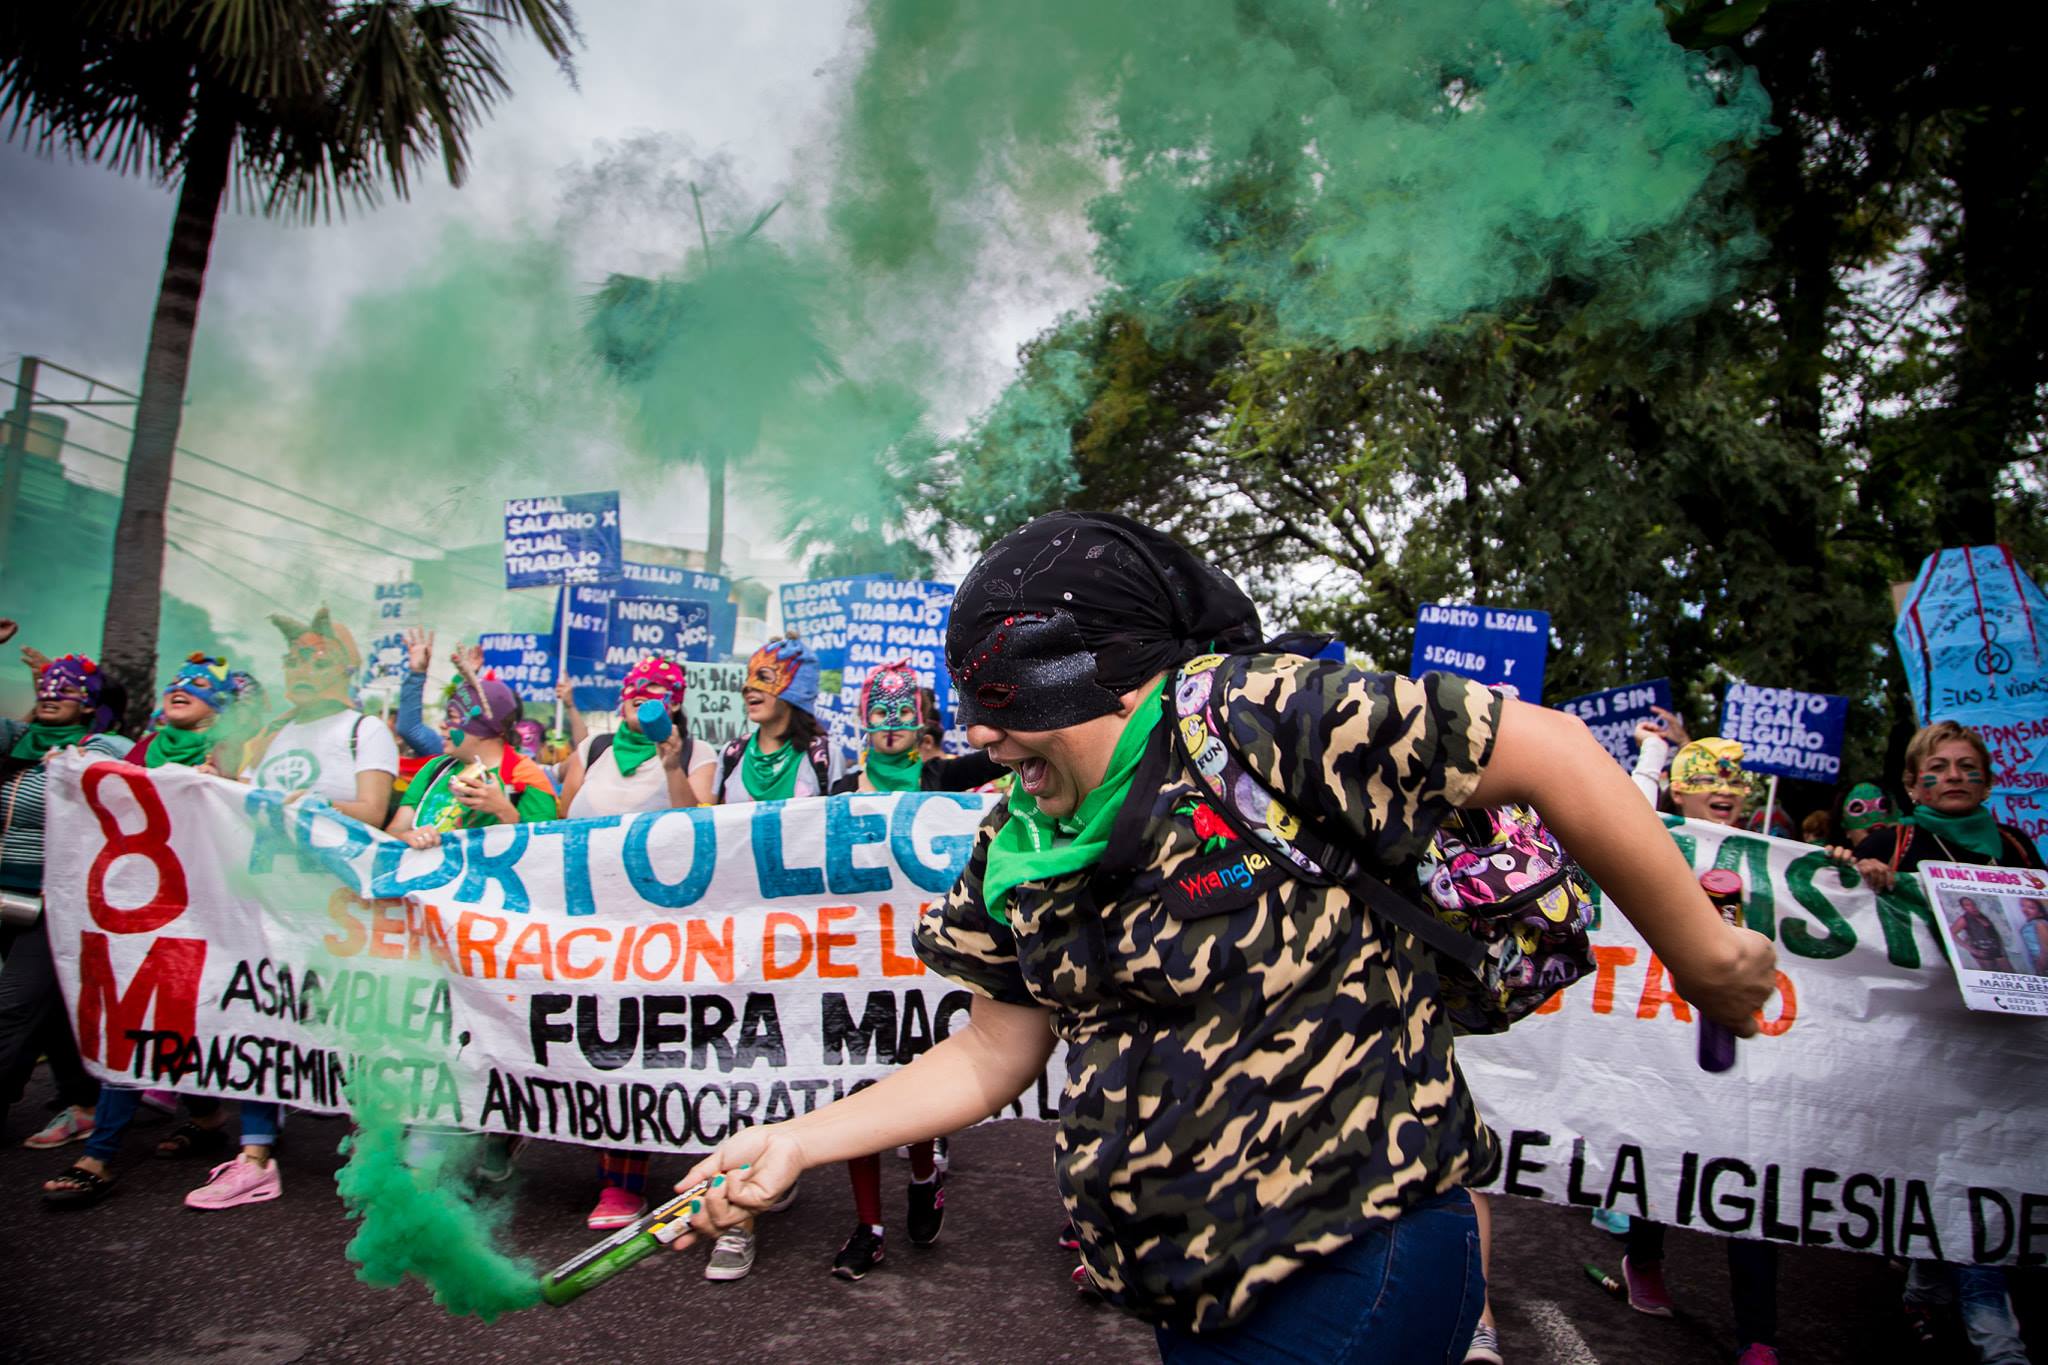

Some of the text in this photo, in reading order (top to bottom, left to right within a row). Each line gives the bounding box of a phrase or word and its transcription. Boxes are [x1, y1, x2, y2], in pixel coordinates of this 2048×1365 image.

[508, 510, 617, 535] SALARIO X
[505, 534, 568, 556] IGUAL
[506, 551, 601, 574] TRABAJO
[624, 565, 720, 591] TRABAJO POR
[865, 581, 928, 599] IGUAL
[785, 599, 843, 619] LEGAL
[851, 602, 943, 626] TRABAJO
[1420, 606, 1538, 633] ABORTO LEGAL
[632, 623, 664, 643] NO
[848, 623, 884, 642] POR
[1423, 645, 1516, 677] SEGURO Y
[1613, 686, 1656, 713] SIN
[1726, 684, 1828, 714] ABORTO
[1727, 702, 1807, 729] LEGAL
[1722, 721, 1824, 750] SEGURO
[1197, 743, 1226, 770] FUN
[80, 761, 188, 934] 8
[244, 788, 984, 917] ABORTO LEG
[323, 887, 927, 984] SEPARACION DE L
[1979, 978, 2024, 990] MAIRA
[79, 931, 207, 1074] M
[530, 990, 787, 1073] FUERA
[124, 1029, 464, 1123] TRANSFEMINISTA
[1567, 1137, 1648, 1217] LA
[1676, 1152, 1944, 1260] IGLESIA
